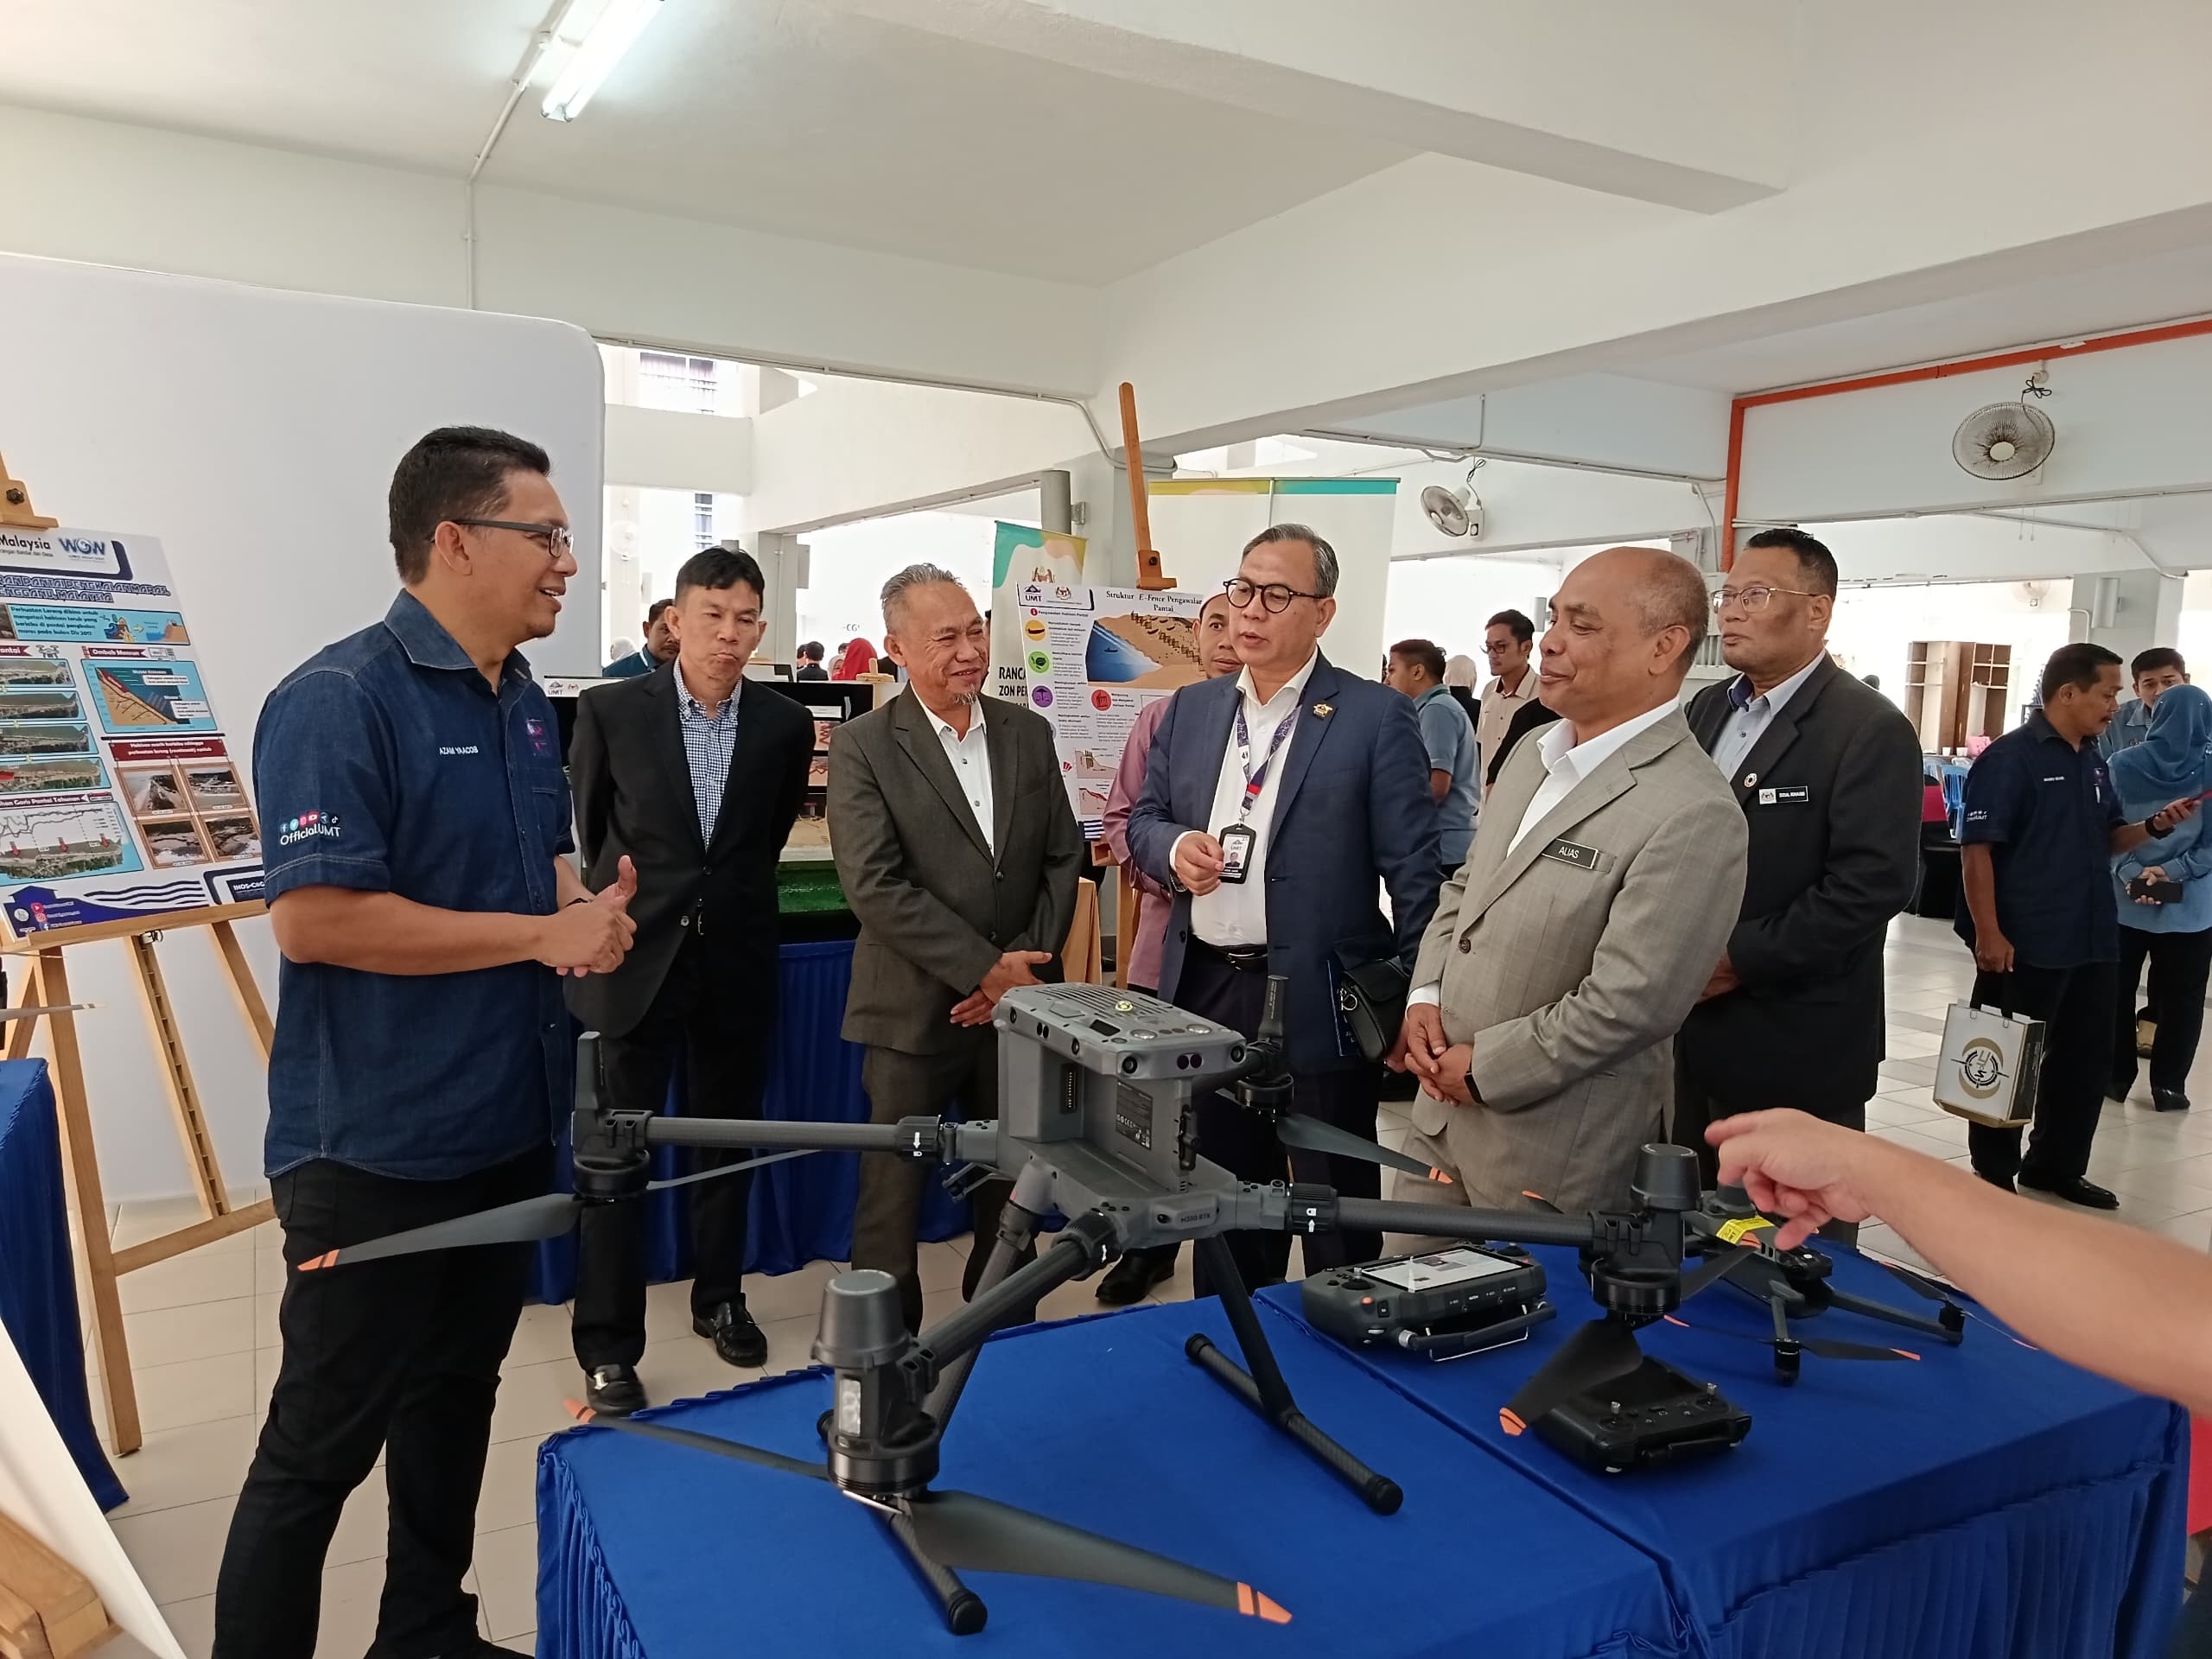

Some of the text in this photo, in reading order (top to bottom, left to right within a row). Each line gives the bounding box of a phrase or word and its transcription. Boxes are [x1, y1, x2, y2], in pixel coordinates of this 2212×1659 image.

[0, 534, 51, 551] Malaysia
[1106, 590, 1135, 600] Struktur
[999, 685, 1014, 696] ZON
[280, 823, 340, 846] OfficialUMT
[1558, 846, 1580, 859] ALIAS
